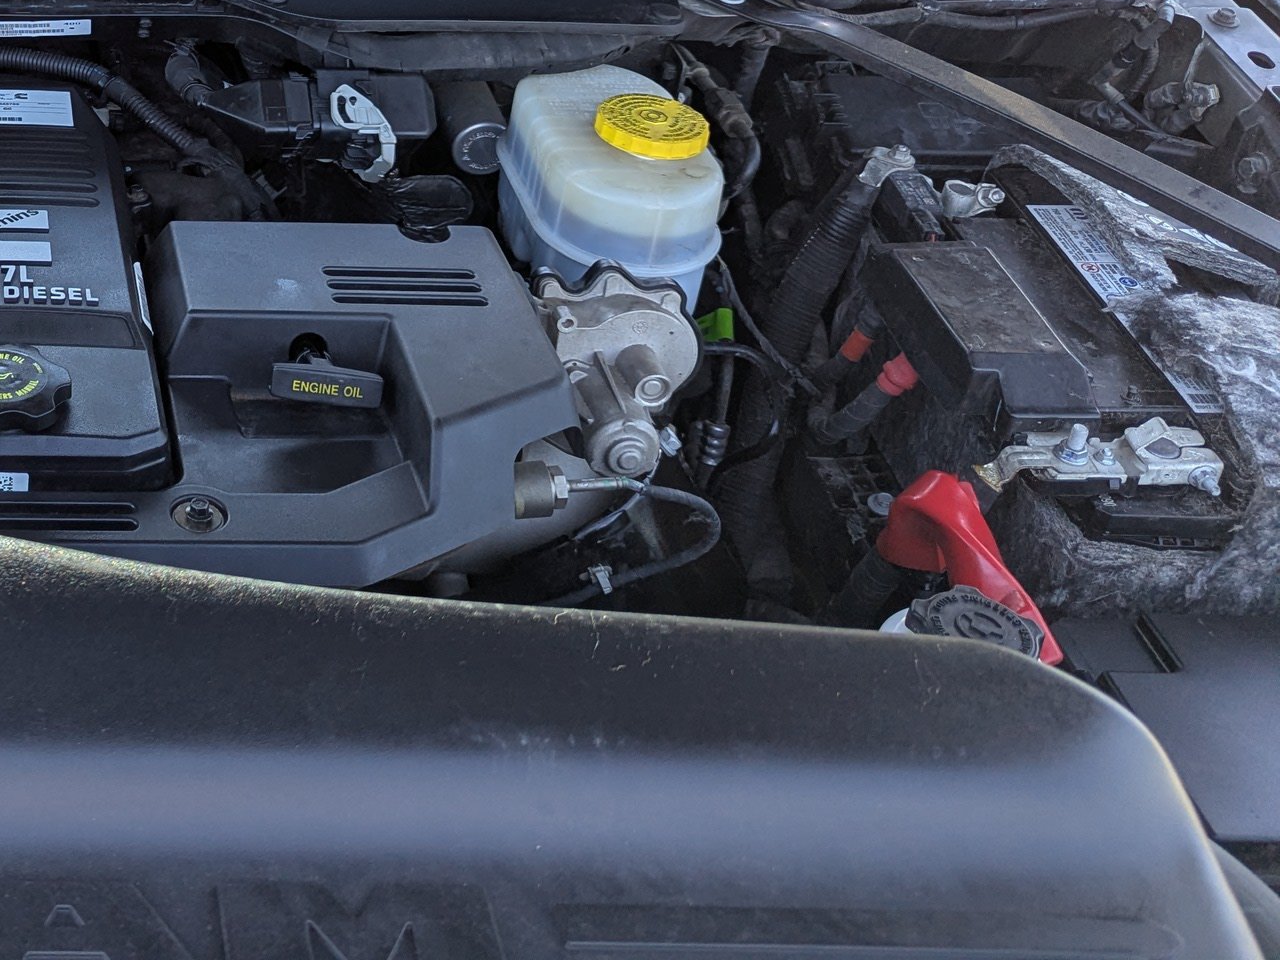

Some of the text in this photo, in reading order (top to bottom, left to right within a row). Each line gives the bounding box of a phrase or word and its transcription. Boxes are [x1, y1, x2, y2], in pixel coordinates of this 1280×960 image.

[3, 287, 99, 304] DIESEL
[11, 355, 25, 364] OIL
[15, 380, 39, 397] MANUAL
[292, 380, 364, 398] ENGINE OIL
